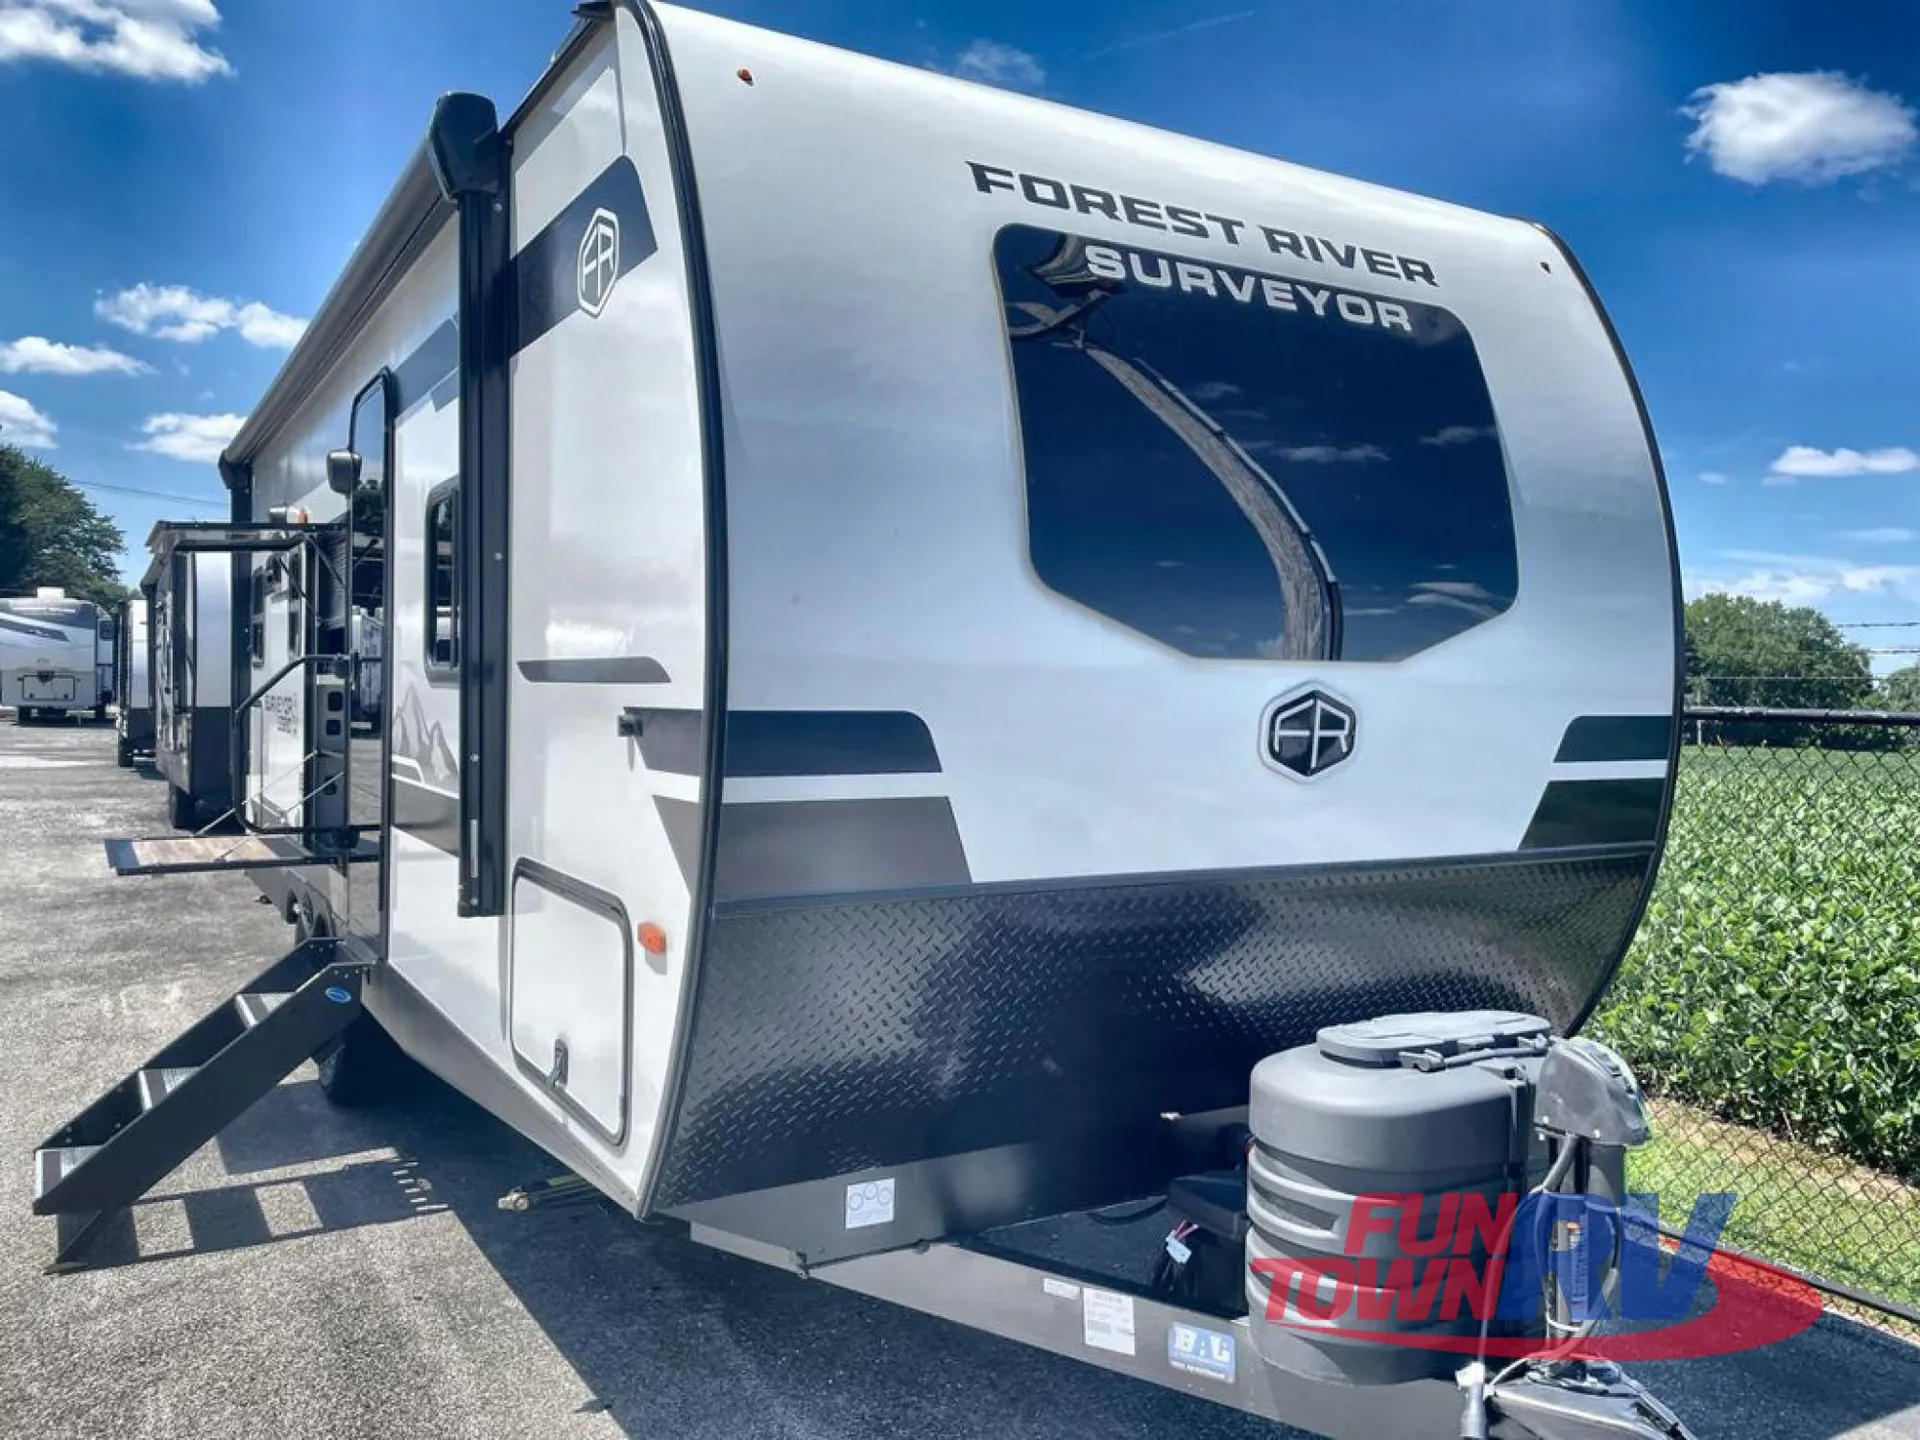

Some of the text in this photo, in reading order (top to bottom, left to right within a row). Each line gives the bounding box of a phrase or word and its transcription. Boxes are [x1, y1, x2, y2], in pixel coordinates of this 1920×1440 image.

[965, 160, 1440, 287] FOREST RIVER
[1085, 245, 1413, 332] SURVEYOR
